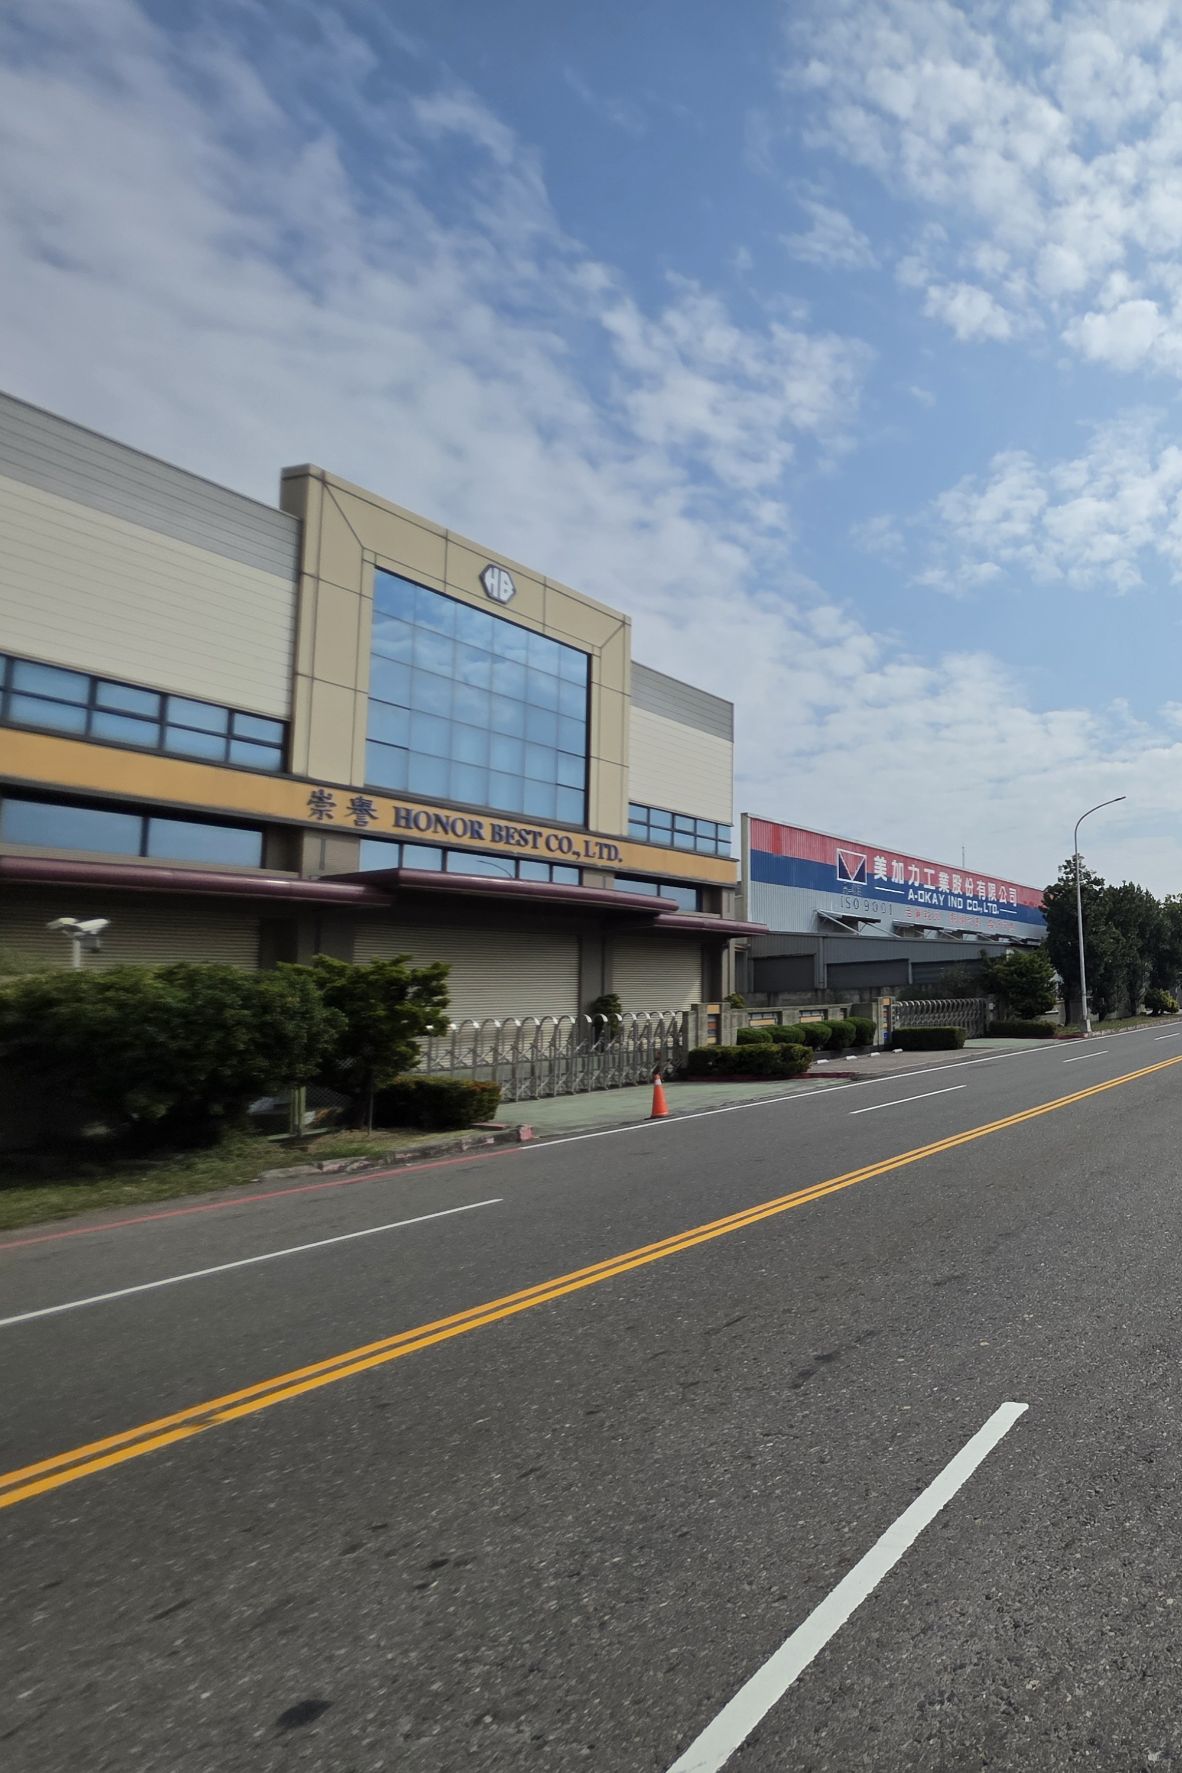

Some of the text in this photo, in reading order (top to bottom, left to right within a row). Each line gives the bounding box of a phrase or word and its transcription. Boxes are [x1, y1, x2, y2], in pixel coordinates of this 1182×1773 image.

[393, 806, 485, 841] HONOR
[490, 822, 543, 850] BEST
[583, 840, 623, 863] LTD.
[873, 855, 1017, 907] 美加力工業股份有限公司
[840, 895, 893, 915] ISO 9001
[948, 895, 964, 909] IND
